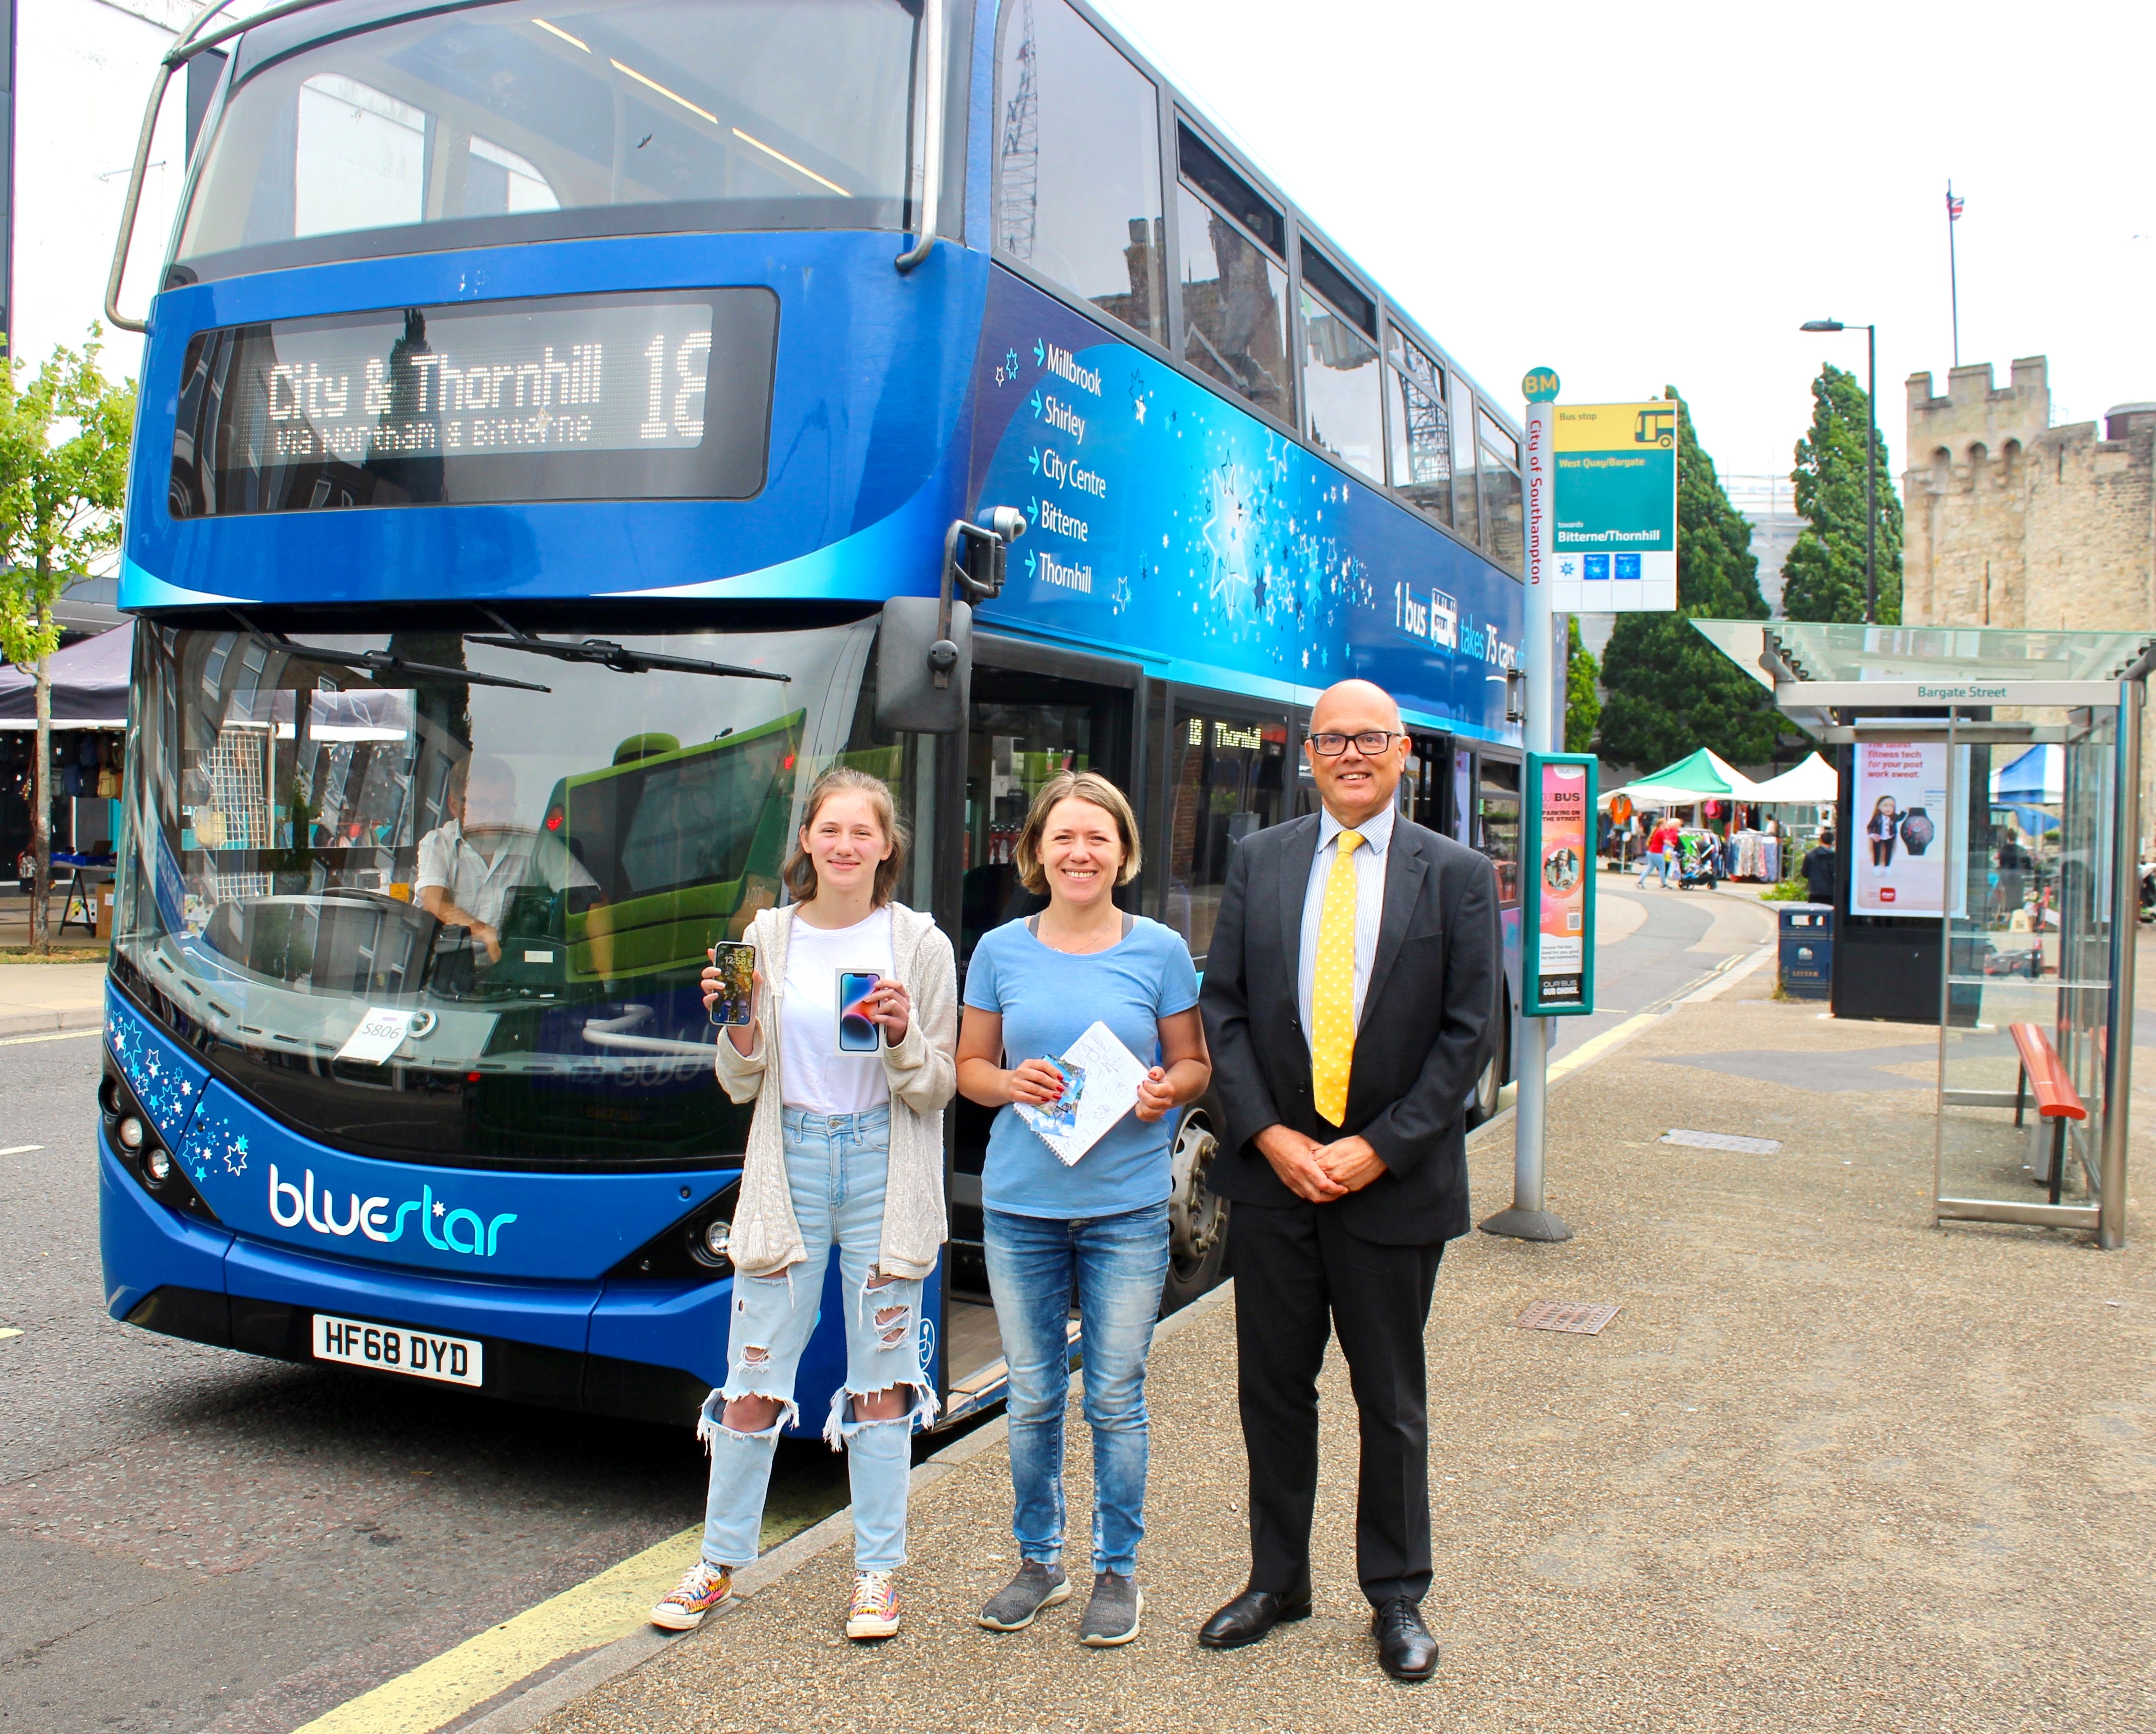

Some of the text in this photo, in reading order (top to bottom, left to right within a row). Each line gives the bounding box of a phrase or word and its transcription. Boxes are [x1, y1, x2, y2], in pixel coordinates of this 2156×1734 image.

[269, 343, 602, 420] City & Thornhill
[1047, 343, 1102, 397] Millbrook
[1525, 374, 1556, 393] BM
[1045, 395, 1086, 445] Shirley
[1559, 412, 1597, 420] Bus stop
[1043, 449, 1106, 499] City Centre
[1559, 457, 1645, 469] West Quay/Bargate
[1528, 419, 1543, 585] City of Southampton
[1041, 500, 1088, 542] Bitterne
[1558, 530, 1661, 542] Bitterne/Thornhill
[1039, 552, 1092, 594] Thornhill
[1394, 581, 1402, 627] 1
[1405, 582, 1426, 637] bus
[1460, 613, 1484, 660] takes
[1486, 623, 1498, 665] 75
[1498, 640, 1516, 669] cars
[1918, 686, 2007, 699] Bargate Street
[1903, 761, 1923, 769] post
[1555, 793, 1580, 801] BUS
[724, 956, 746, 965] 12:58
[1557, 986, 1579, 994] CHOICE.
[362, 1023, 402, 1039] S806
[267, 1164, 517, 1257] bluestar
[326, 1321, 467, 1377] HF68 DYD
